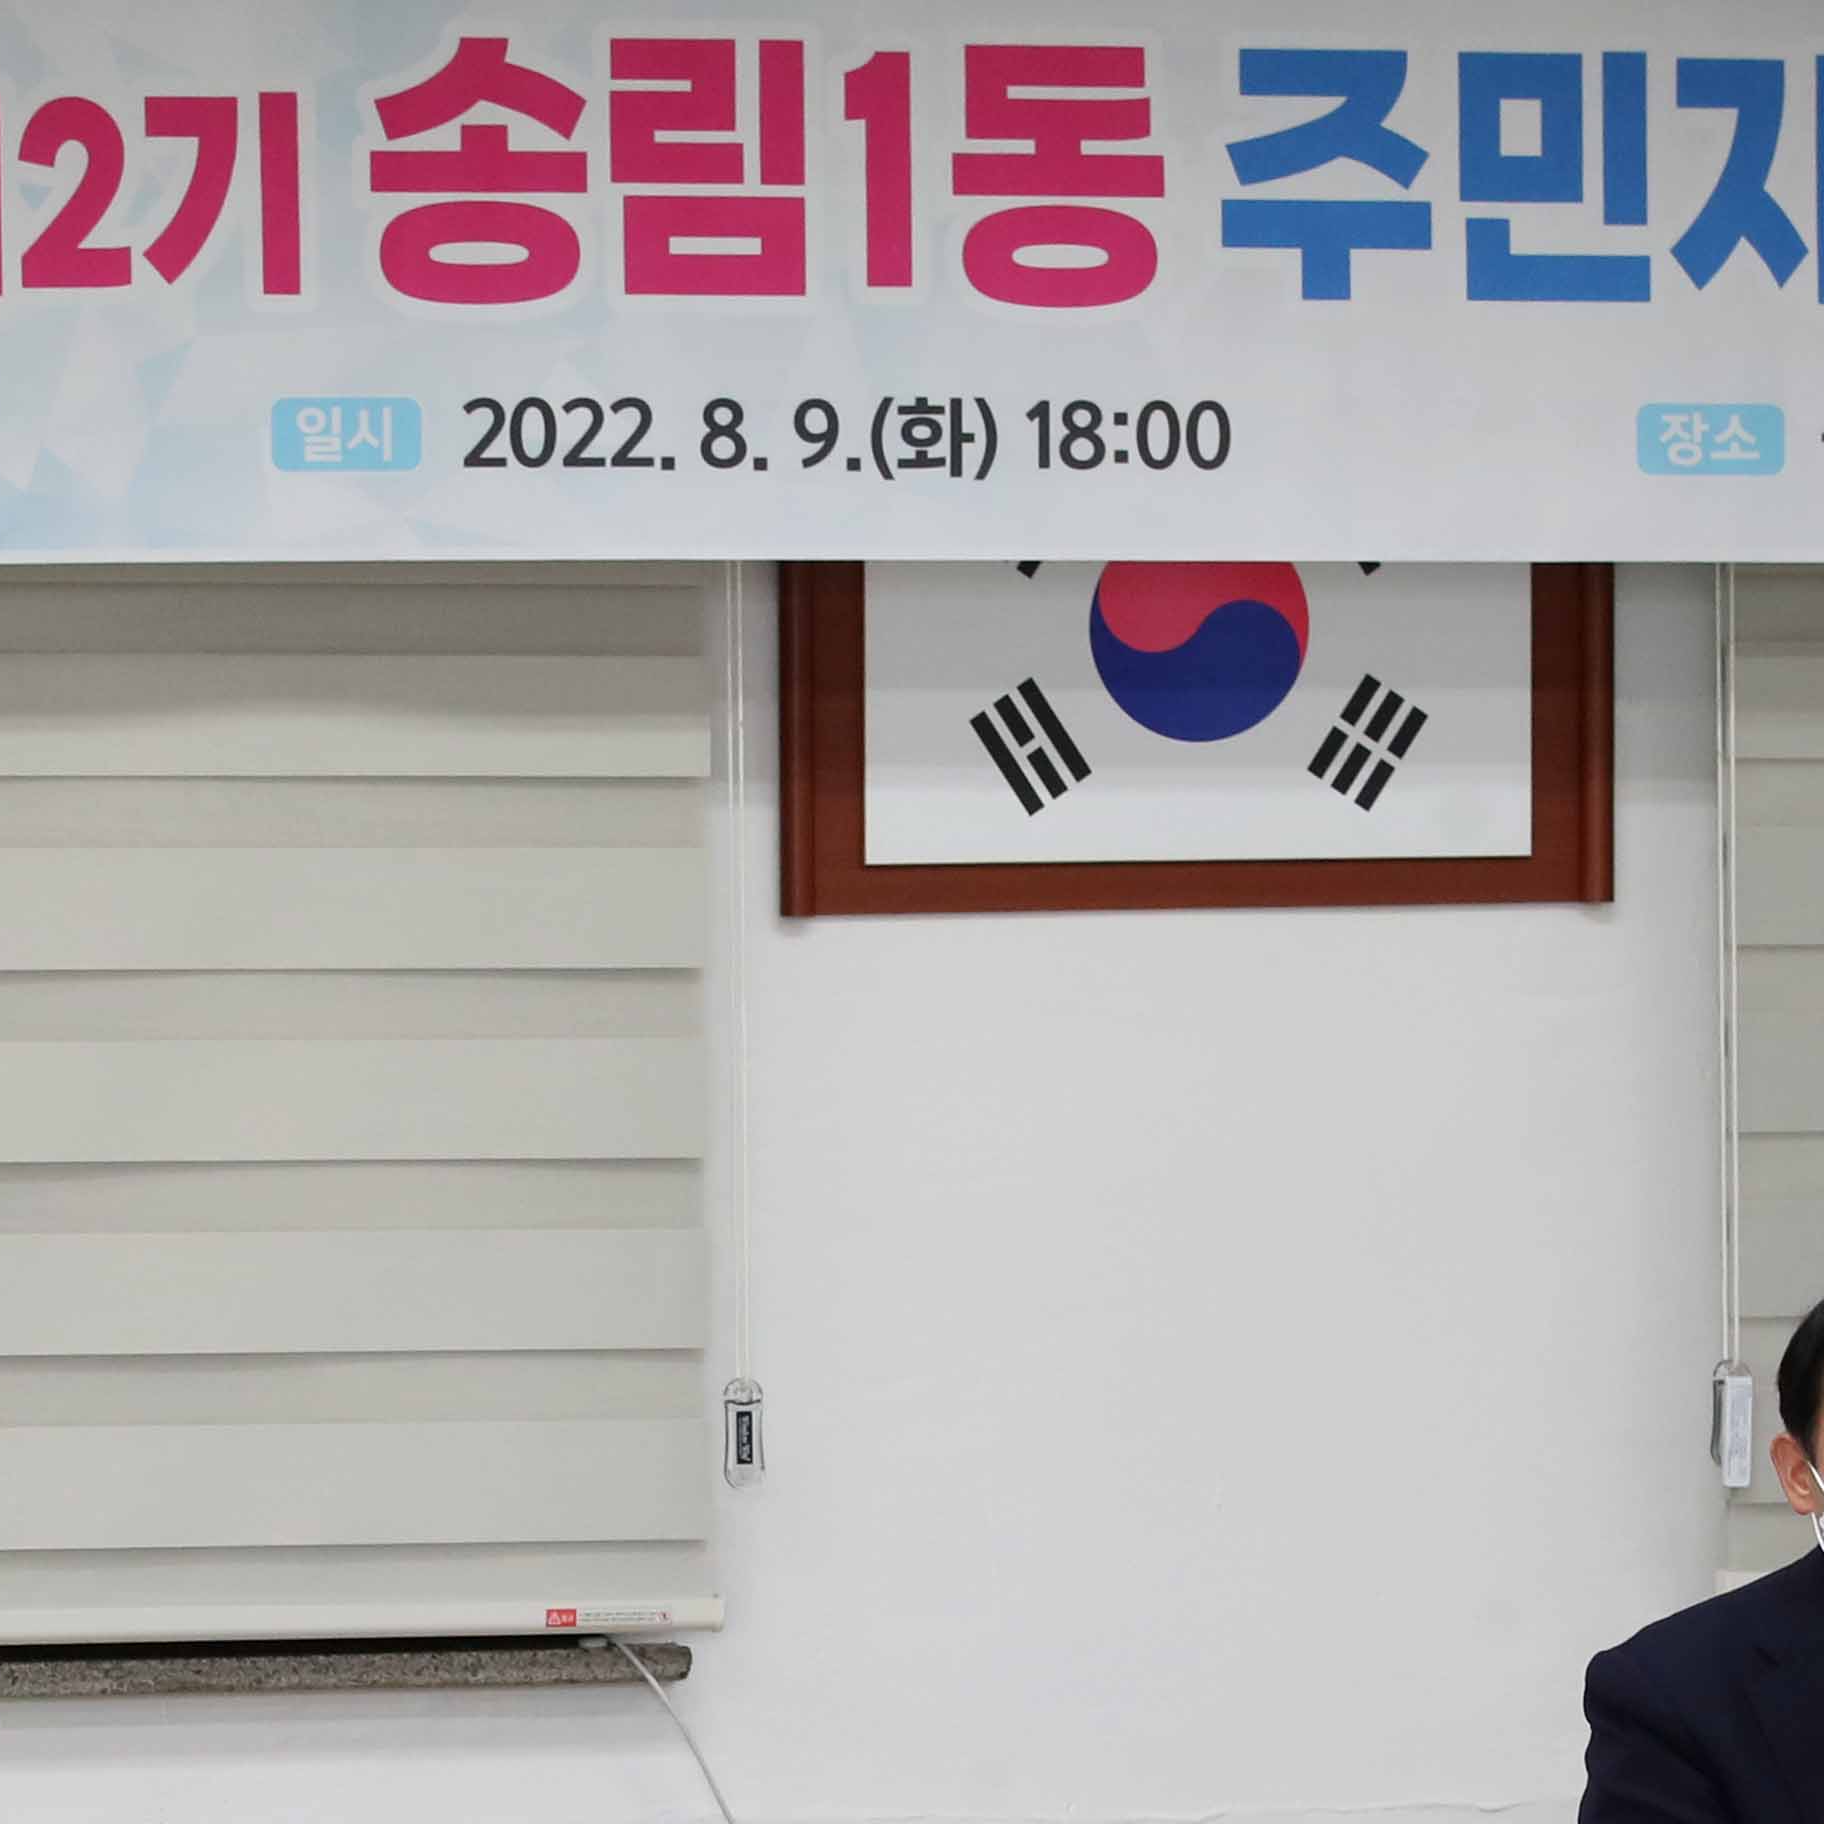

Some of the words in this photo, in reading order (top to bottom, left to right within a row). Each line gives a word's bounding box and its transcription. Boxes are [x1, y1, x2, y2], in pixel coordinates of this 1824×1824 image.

[369, 36, 1167, 309] 송림1동
[295, 404, 397, 464] 일시
[462, 396, 676, 472] 2022.
[699, 396, 769, 472] 8.
[793, 396, 999, 482] 9.(화)
[1026, 398, 1232, 471] 18:00
[1658, 410, 1762, 467] 장소
